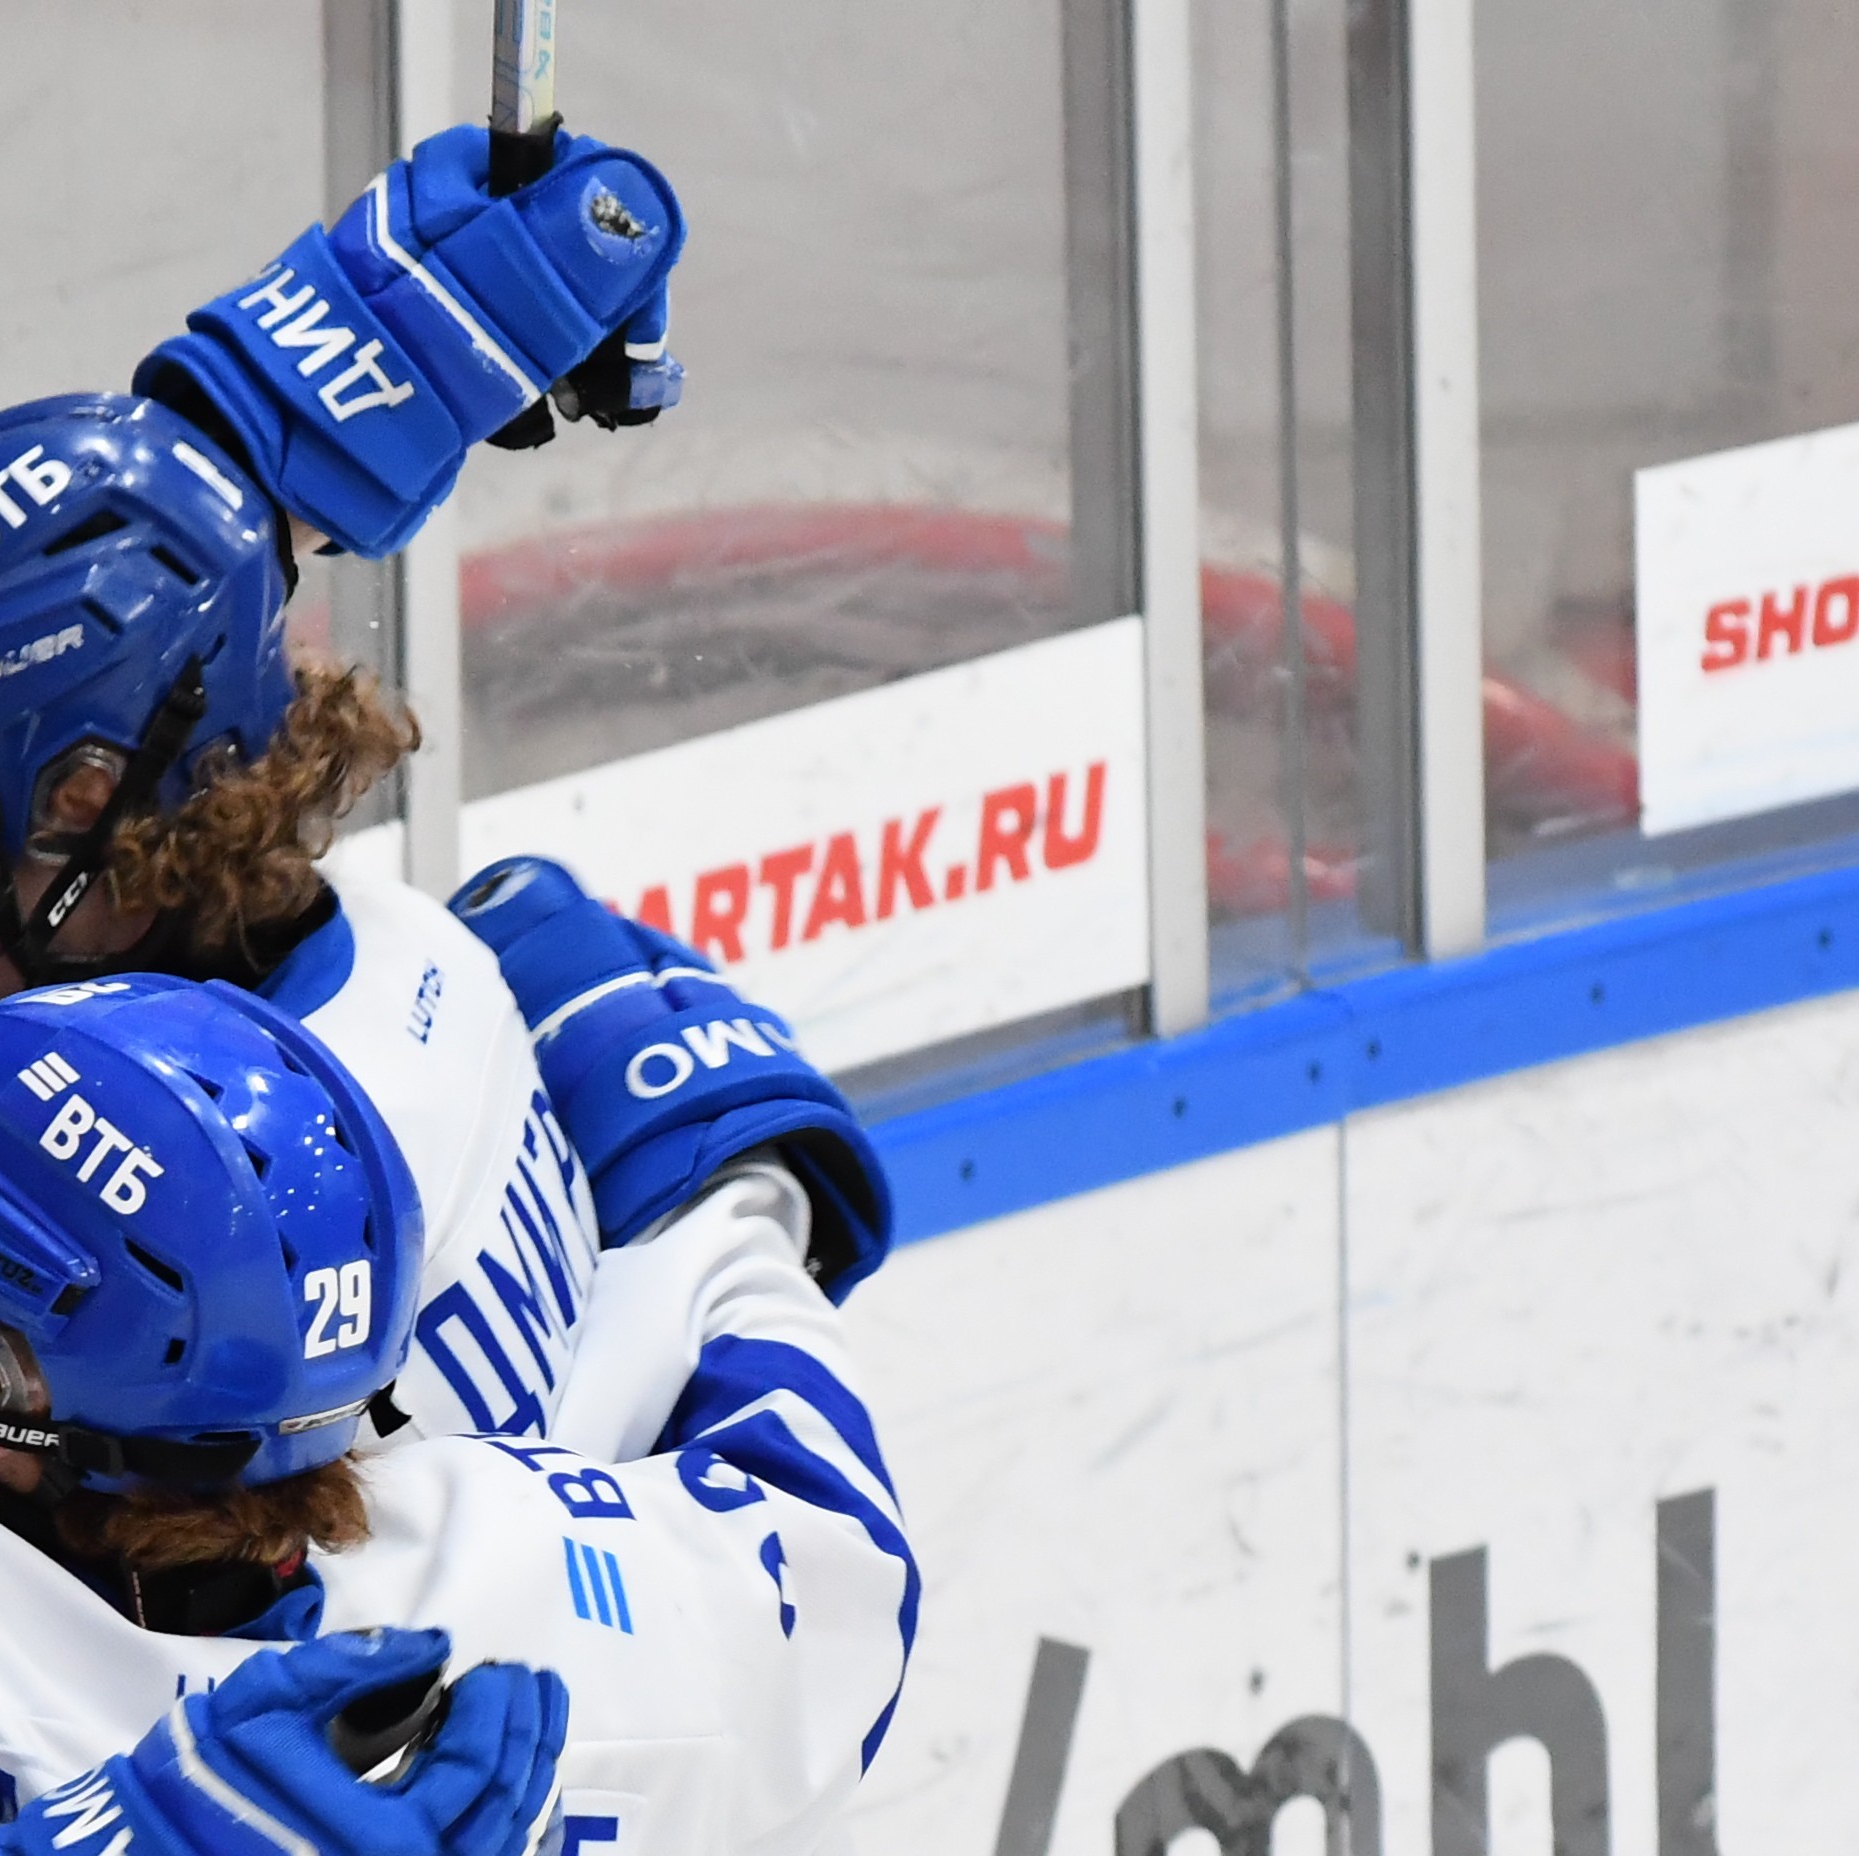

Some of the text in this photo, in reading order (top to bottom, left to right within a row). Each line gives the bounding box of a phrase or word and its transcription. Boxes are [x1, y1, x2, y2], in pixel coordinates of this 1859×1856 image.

[238, 262, 415, 422] ДИН
[1700, 570, 1859, 673] SHO
[605, 759, 1106, 965] ARTAK.RU
[39, 1093, 165, 1215] ВТБ
[303, 1259, 371, 1360] 29
[449, 1432, 637, 1520] ВТ
